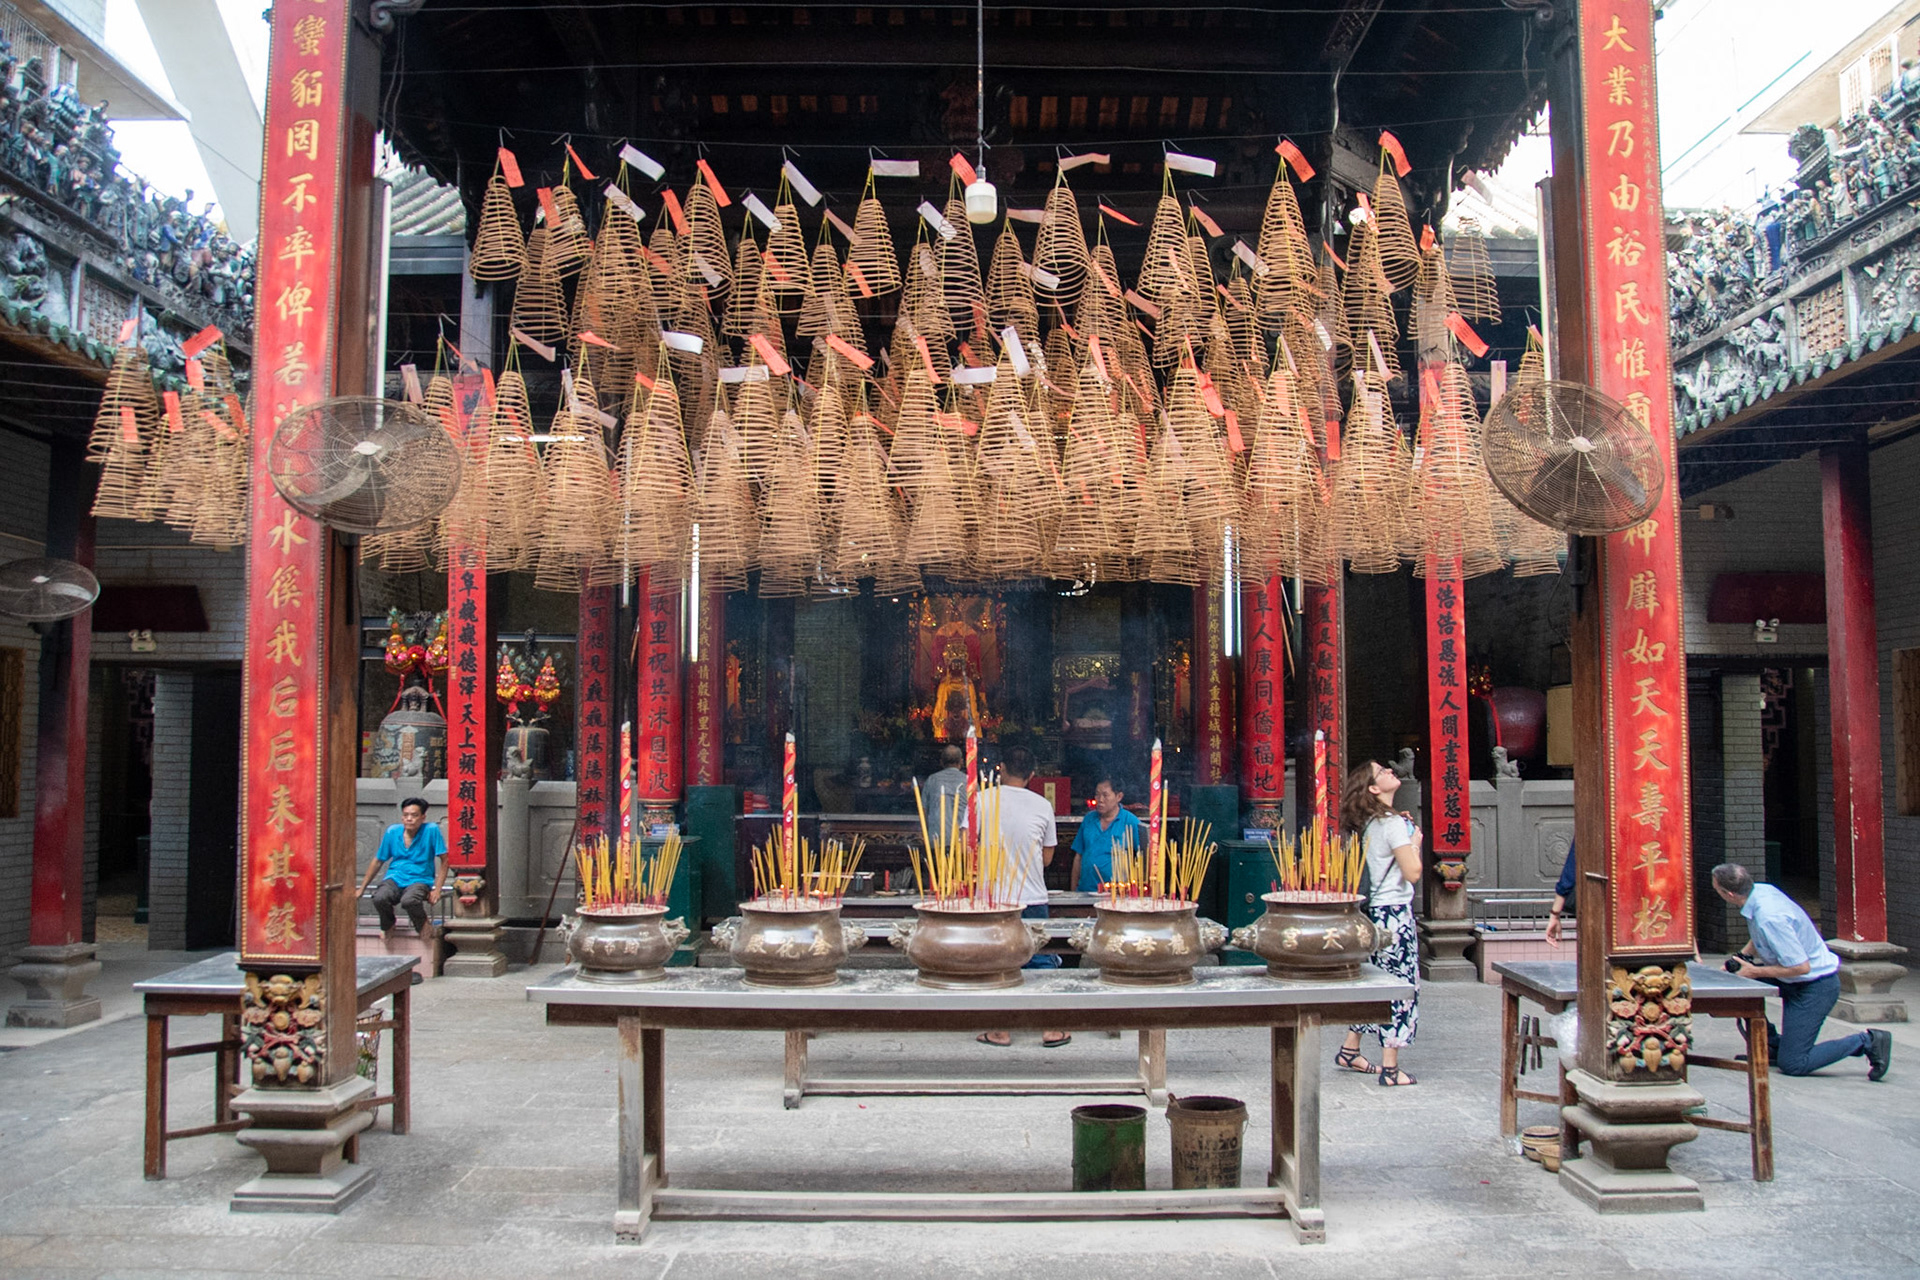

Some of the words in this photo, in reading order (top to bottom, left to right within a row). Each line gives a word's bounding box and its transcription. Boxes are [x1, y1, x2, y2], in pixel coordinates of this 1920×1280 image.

[647, 574, 673, 794] 歌里祝共沐恩波
